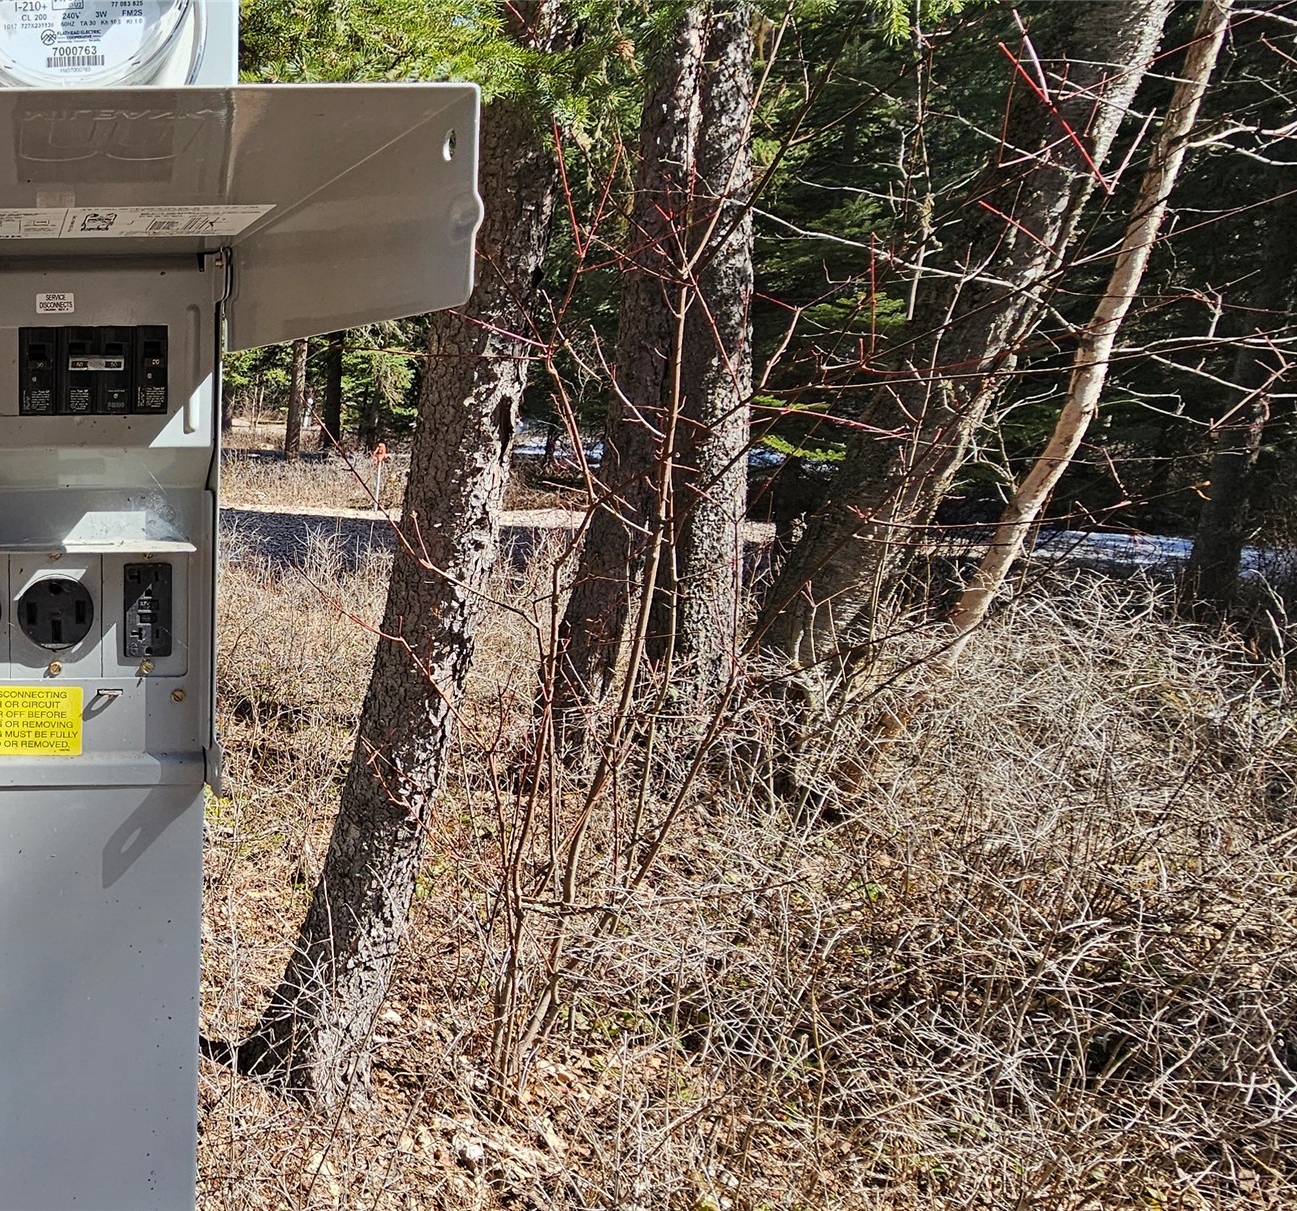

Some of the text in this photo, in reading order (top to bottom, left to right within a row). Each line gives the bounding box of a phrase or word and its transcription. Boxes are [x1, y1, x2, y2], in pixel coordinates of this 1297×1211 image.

[14, 1, 48, 12] I-210+
[122, 9, 143, 17] FM2S
[52, 46, 97, 56] 7000763
[21, 701, 61, 709] CIRCUIT
[28, 711, 67, 719] BEFORE
[22, 721, 74, 729] REMOVING
[50, 731, 79, 739] FULLY
[4, 740, 19, 748] OR
[20, 740, 70, 748] REMOVED.
